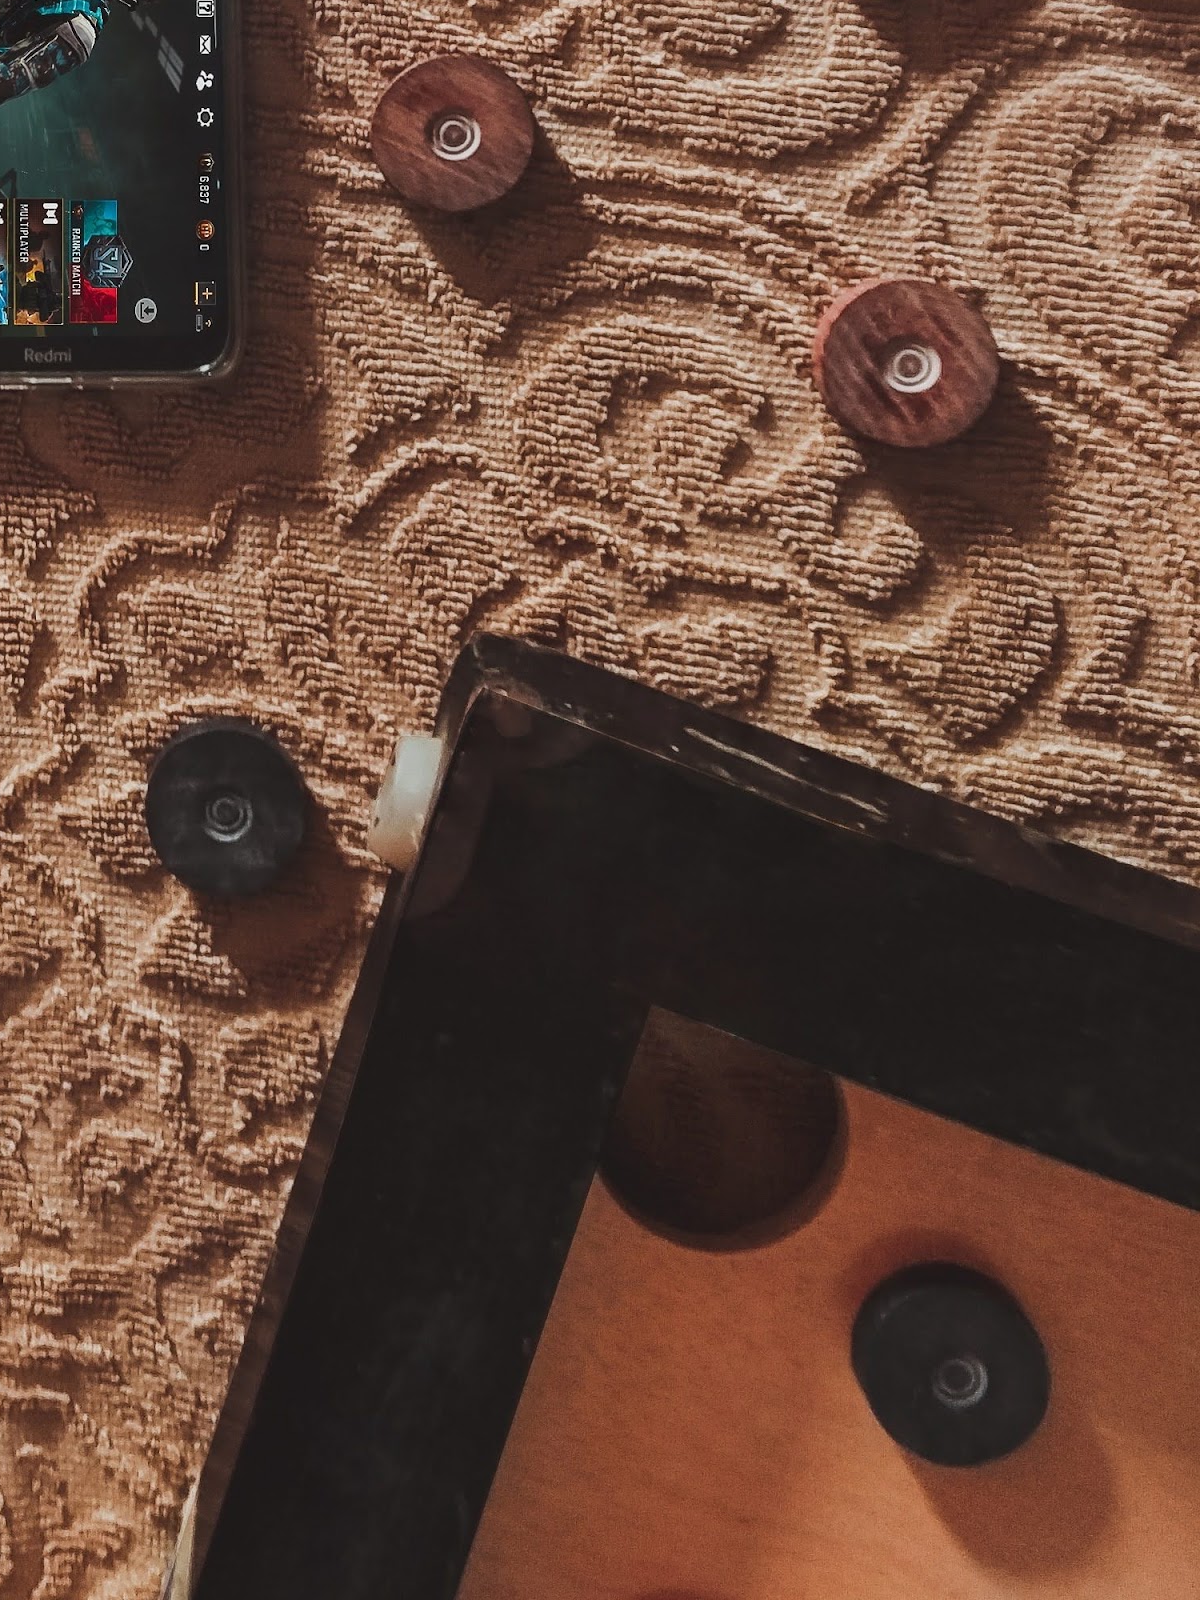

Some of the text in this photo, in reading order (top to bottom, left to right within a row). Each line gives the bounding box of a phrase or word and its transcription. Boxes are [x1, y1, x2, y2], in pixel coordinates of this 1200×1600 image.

[199, 175, 210, 205] 6,837
[20, 203, 29, 263] MULTIPLAYER
[72, 228, 81, 296] RANKED MATCH
[24, 347, 72, 363] Redmi
